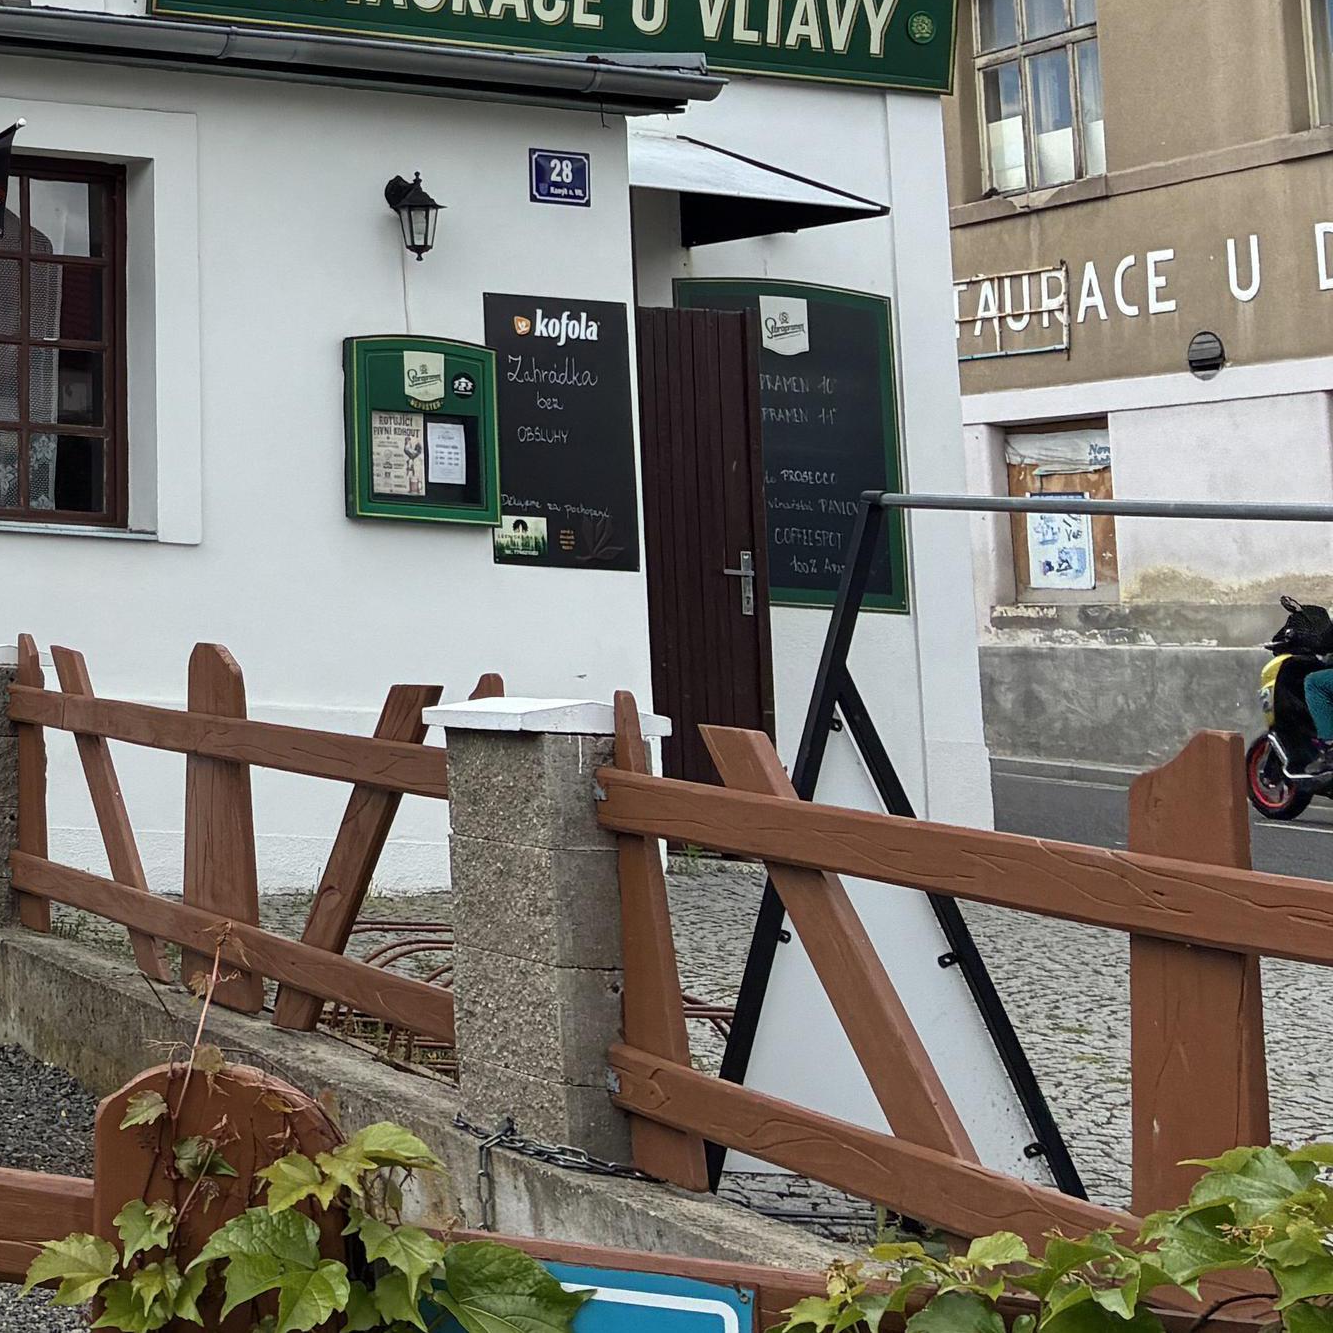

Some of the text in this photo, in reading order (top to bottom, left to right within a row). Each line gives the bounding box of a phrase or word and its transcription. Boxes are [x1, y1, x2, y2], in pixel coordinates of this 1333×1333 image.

[549, 158, 573, 183] 28
[1226, 234, 1261, 302] U
[534, 308, 598, 347] kofola
[507, 354, 598, 387] Zahrádka
[536, 391, 564, 411] bez
[517, 425, 571, 444] OBSLUHY
